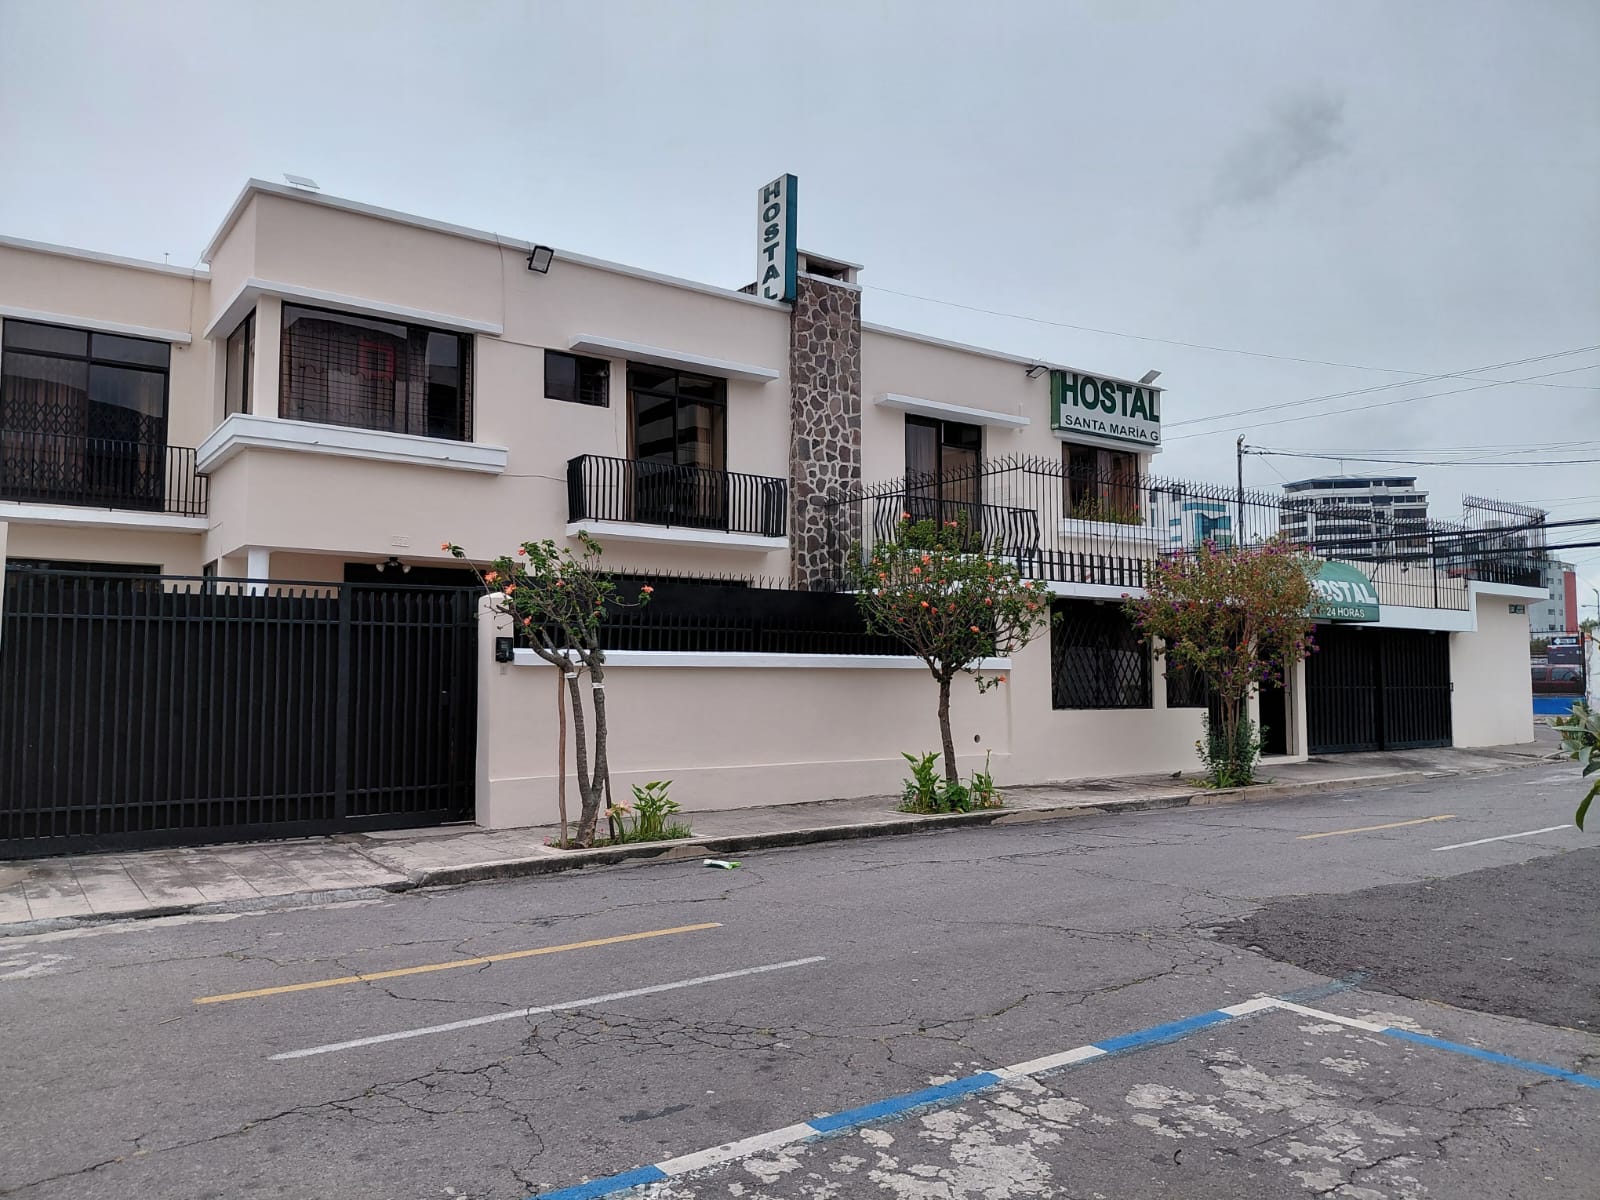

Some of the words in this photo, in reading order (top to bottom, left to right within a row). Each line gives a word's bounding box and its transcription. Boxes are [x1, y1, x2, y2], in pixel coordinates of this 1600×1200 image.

[762, 180, 781, 300] HOSTAL
[1060, 370, 1160, 422] HOSTAL
[1065, 414, 1106, 432] SANTA
[1150, 430, 1159, 441] G
[1326, 607, 1336, 617] 24
[1337, 607, 1365, 618] HORAS
